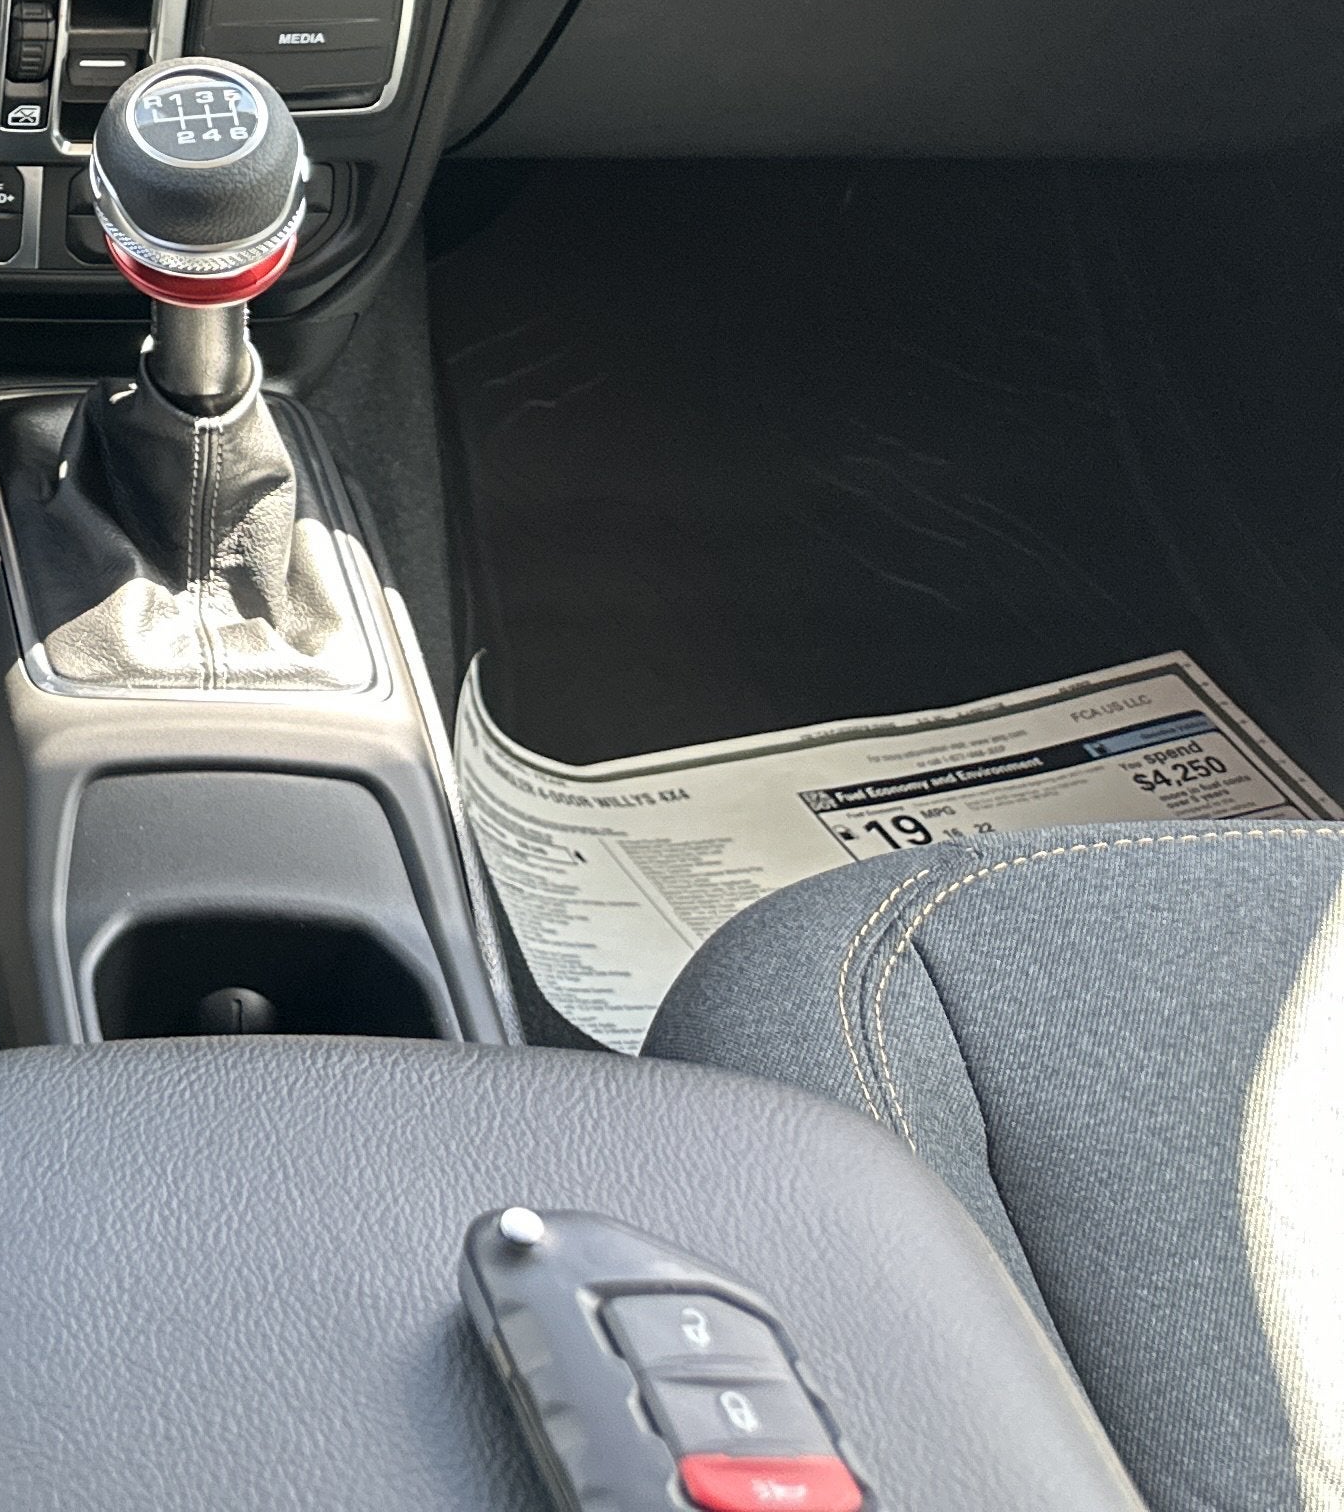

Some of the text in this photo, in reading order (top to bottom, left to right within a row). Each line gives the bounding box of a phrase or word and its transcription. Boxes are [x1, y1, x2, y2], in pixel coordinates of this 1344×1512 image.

[278, 32, 325, 45] MEDIA
[195, 90, 214, 104] 3
[176, 126, 249, 144] 2 4 6
[1070, 705, 1101, 723] FCA
[1122, 694, 1152, 713] LLC
[1143, 740, 1203, 765] spend
[835, 789, 865, 804] Fuel
[867, 779, 930, 798] Economy
[930, 773, 956, 788] and
[957, 757, 1044, 782] Environment
[1133, 755, 1228, 792] $4,250
[595, 793, 656, 809] WILLYS
[920, 805, 956, 819] MPG
[864, 815, 933, 850] 19
